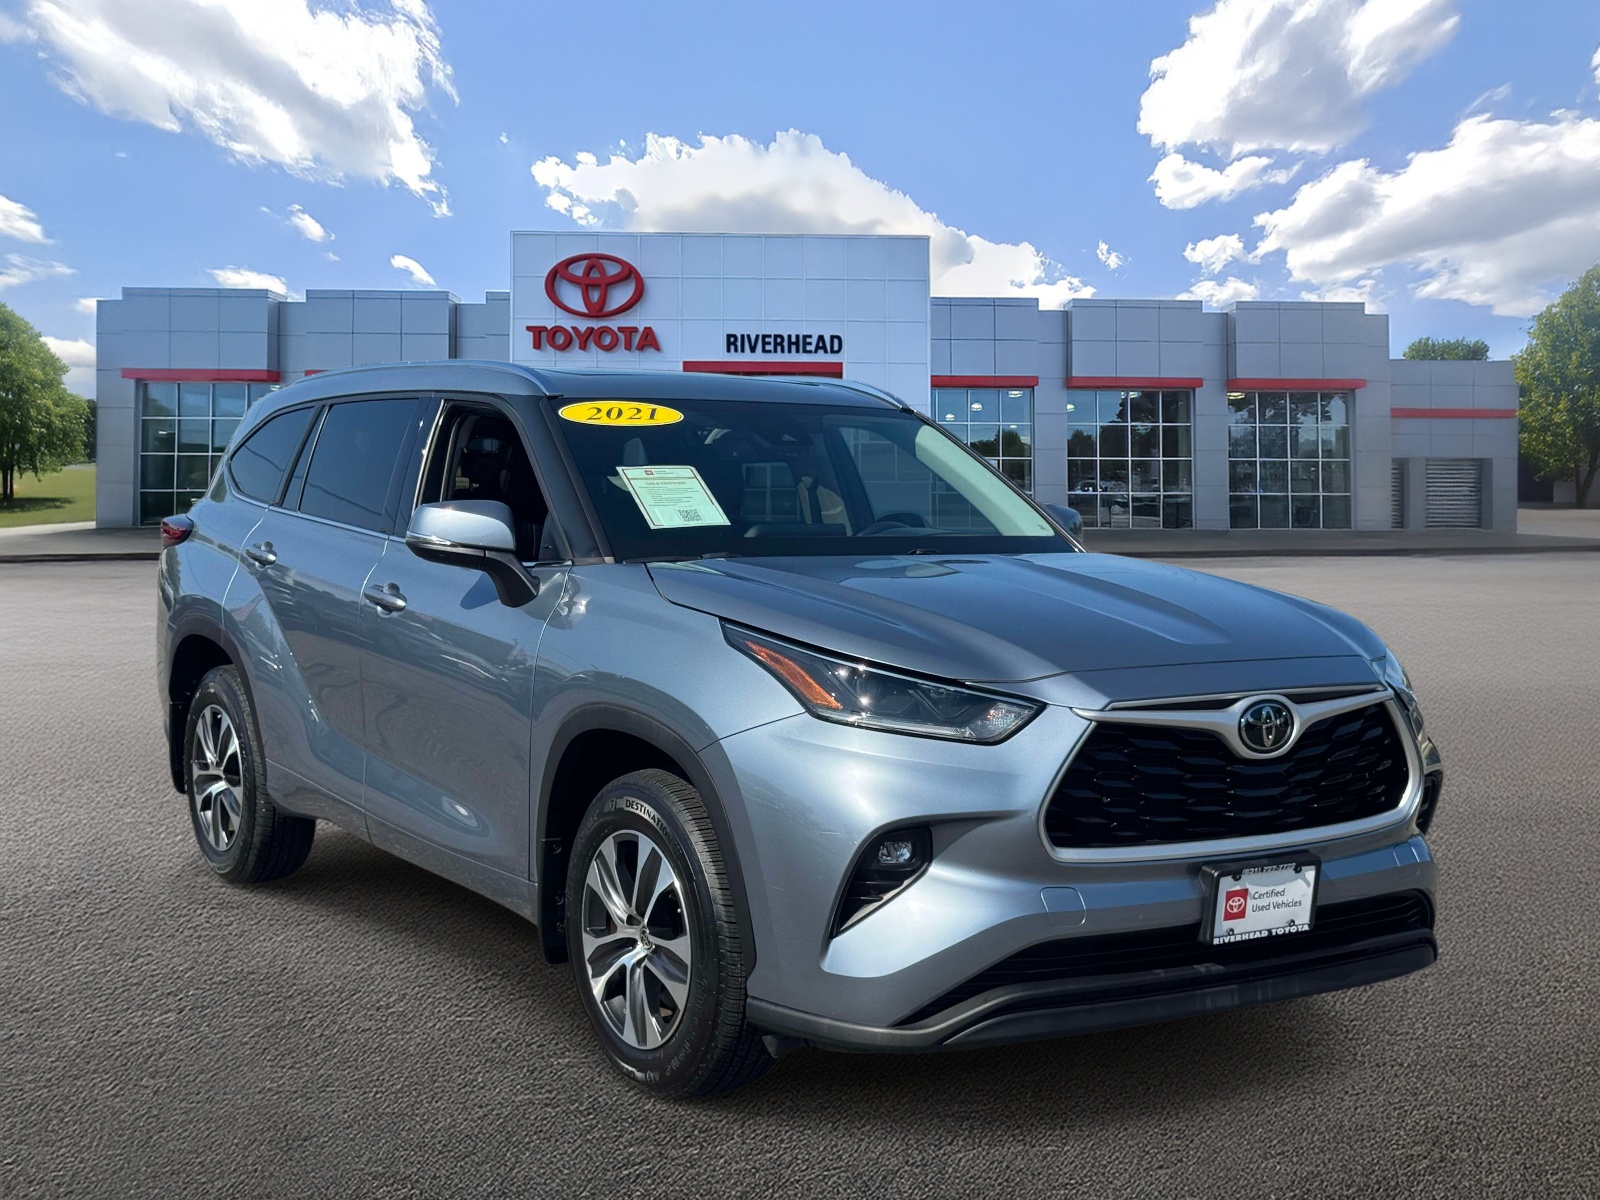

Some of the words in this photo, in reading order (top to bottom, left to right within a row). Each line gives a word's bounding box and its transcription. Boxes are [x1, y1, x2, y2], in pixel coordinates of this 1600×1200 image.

[526, 326, 661, 352] TOYOTA
[726, 333, 843, 354] RIVERHEAD
[586, 406, 659, 421] 2021
[1252, 888, 1286, 900] Certified
[1251, 900, 1271, 913] Used
[1272, 898, 1302, 911] Vehicles
[1213, 930, 1269, 945] RIVERHEAD
[1271, 924, 1310, 936] TOYOTA
